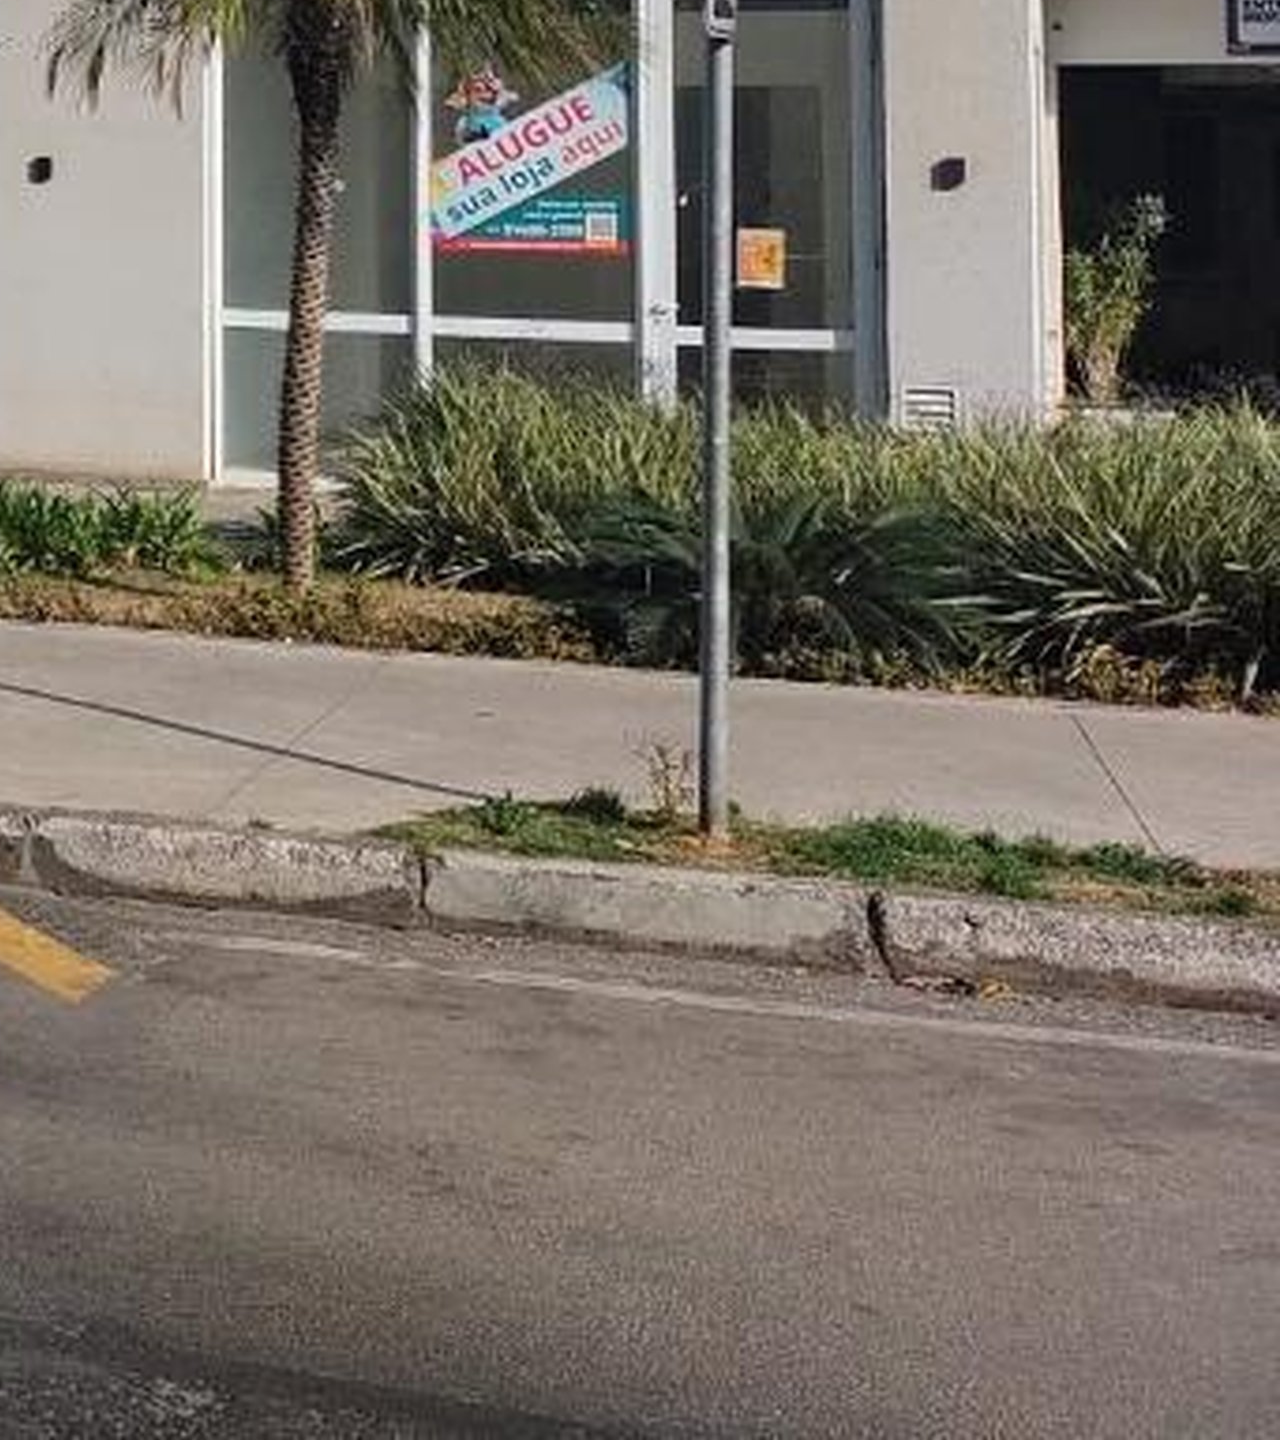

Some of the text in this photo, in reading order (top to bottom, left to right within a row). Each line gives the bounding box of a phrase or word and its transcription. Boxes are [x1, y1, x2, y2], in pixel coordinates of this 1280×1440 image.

[446, 121, 625, 223] sua loja aqui
[456, 96, 593, 186] ALUGUE
